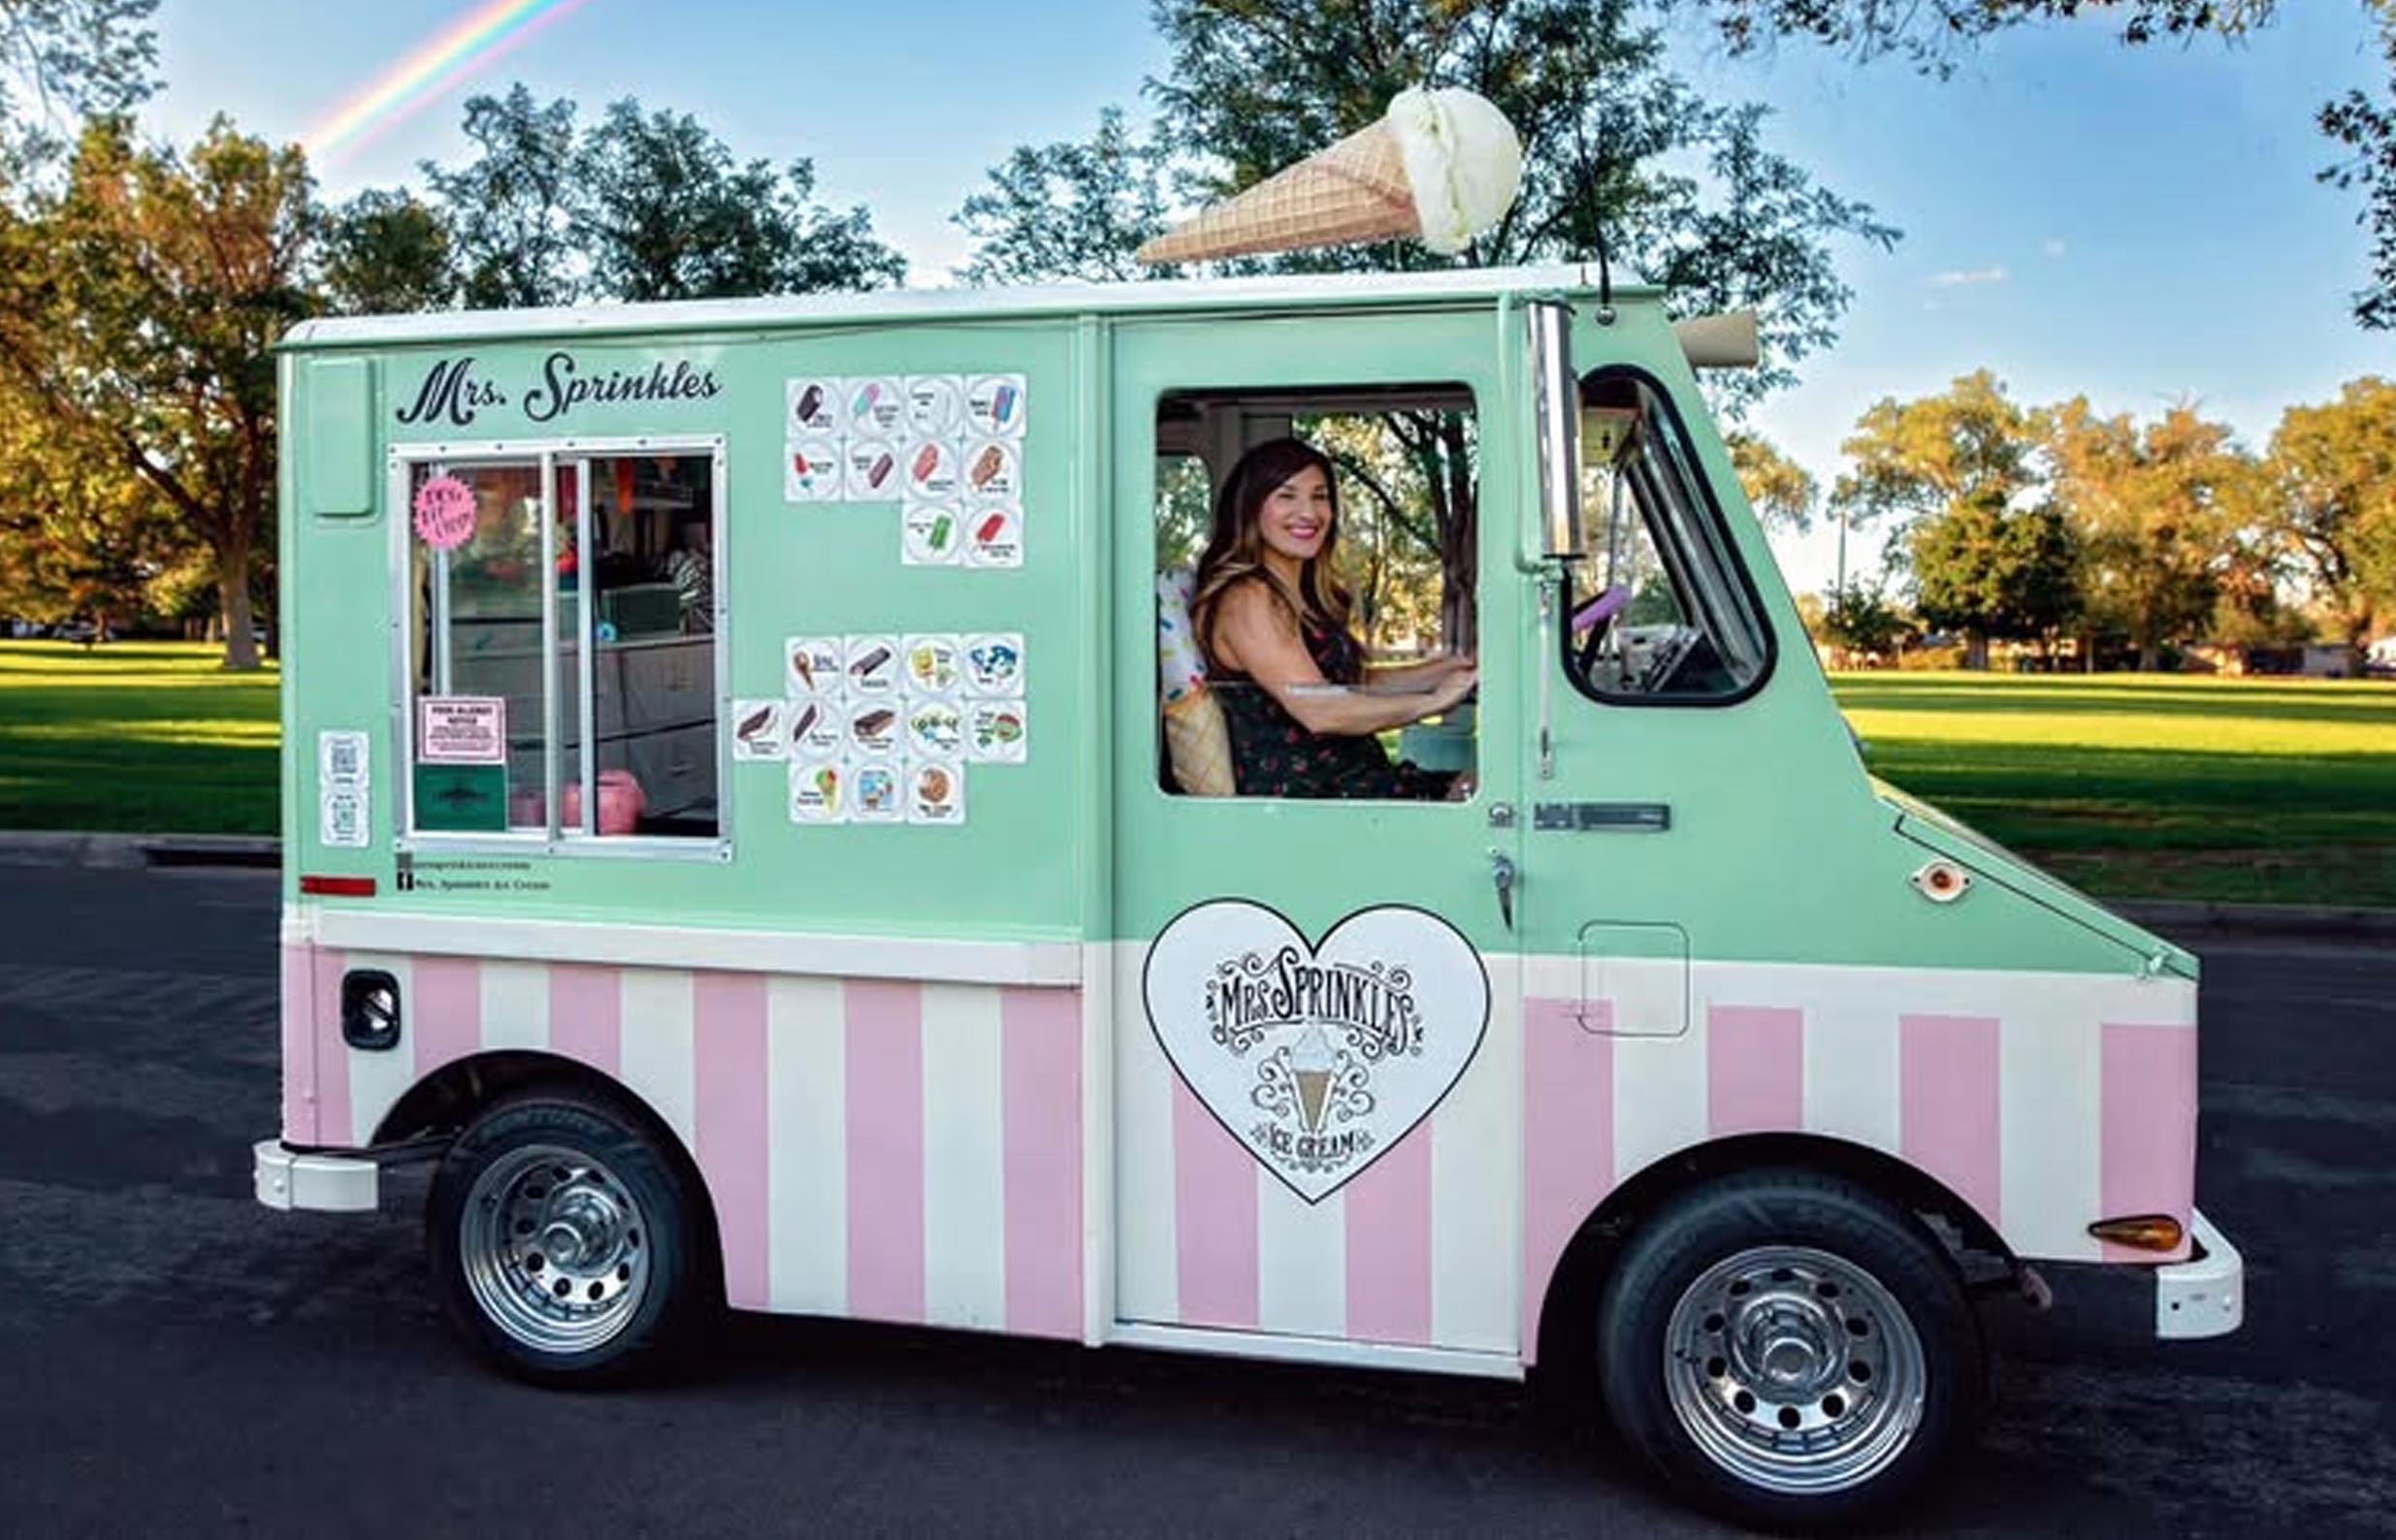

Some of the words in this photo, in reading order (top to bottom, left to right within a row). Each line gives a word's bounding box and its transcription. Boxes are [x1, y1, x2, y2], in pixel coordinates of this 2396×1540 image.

[396, 357, 506, 426] Mrs.
[524, 351, 723, 423] Sprinkles
[1269, 1121, 1294, 1155] ICE
[1296, 1131, 1358, 1159] CREAM
